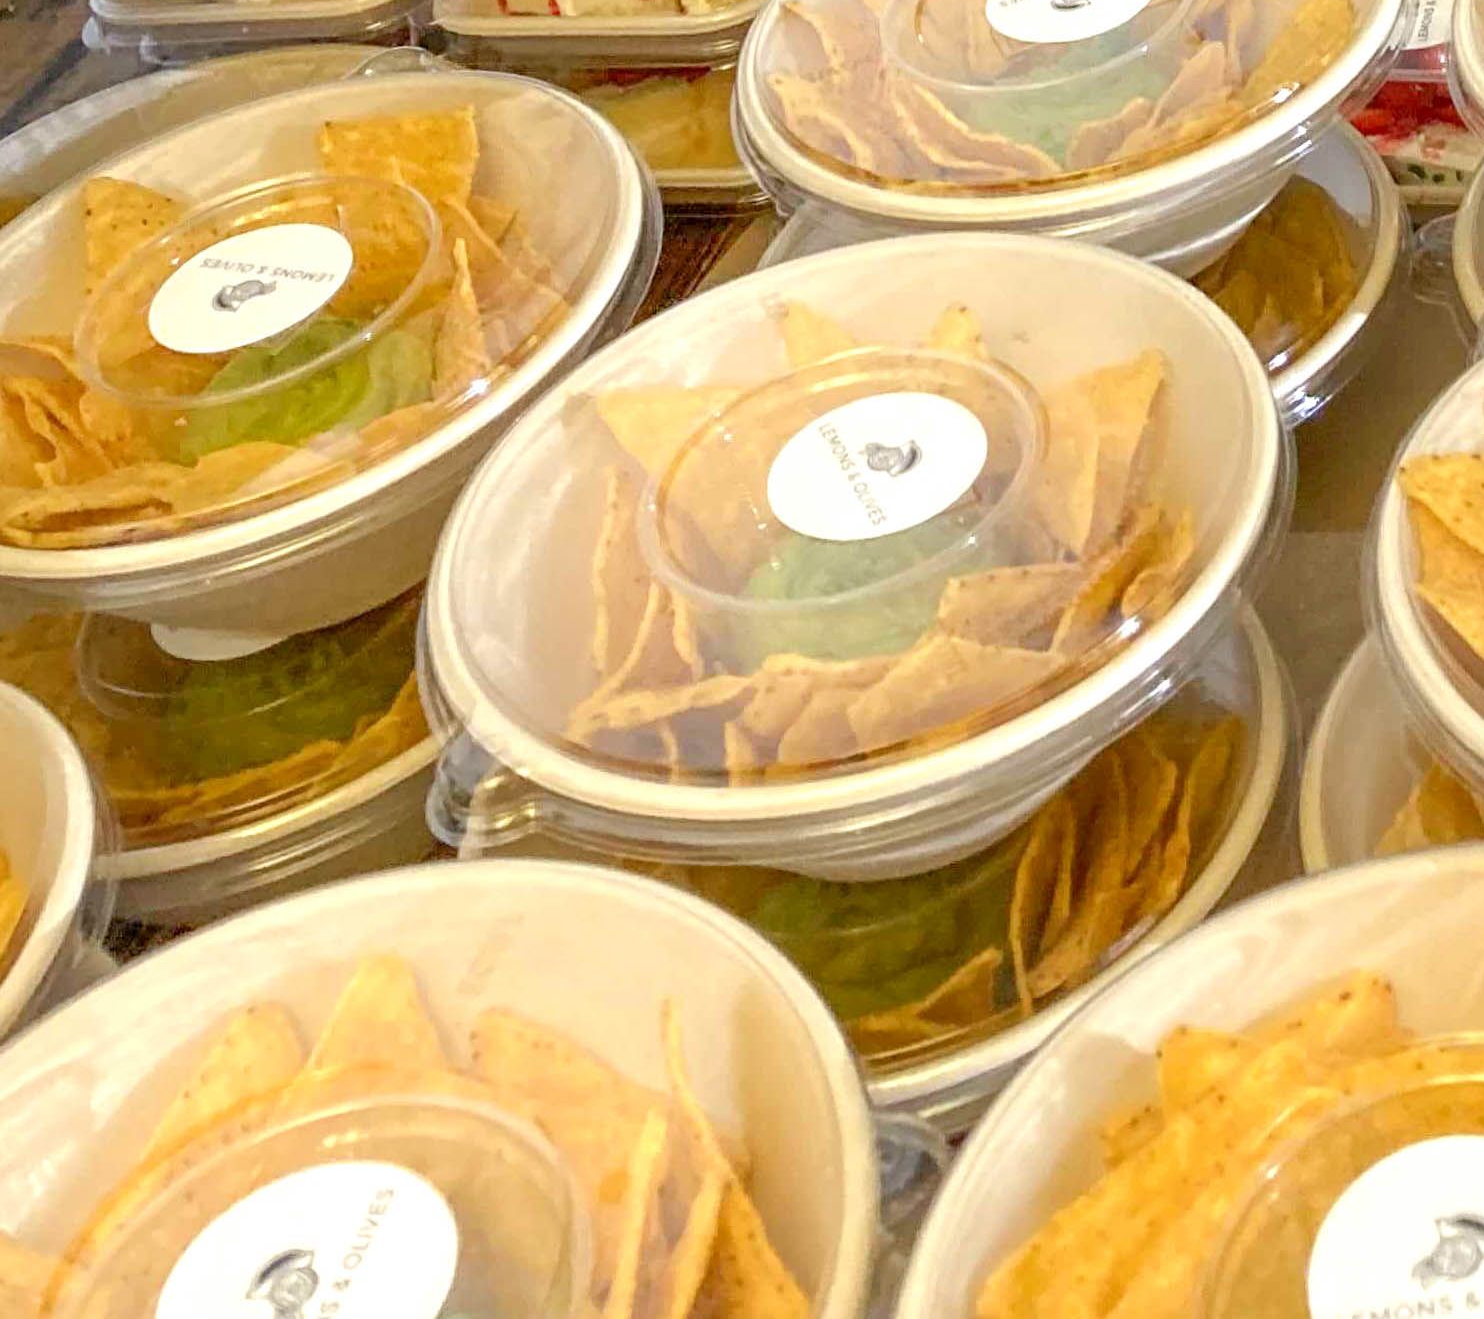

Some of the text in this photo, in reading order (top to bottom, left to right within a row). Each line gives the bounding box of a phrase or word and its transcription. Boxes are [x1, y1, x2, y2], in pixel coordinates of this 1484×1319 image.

[1417, 7, 1435, 42] LEMONS
[199, 257, 256, 275] OLIVES
[269, 266, 336, 283] LEMONS
[818, 421, 857, 473] LEMONS
[852, 481, 888, 526] OLIVES
[342, 1187, 395, 1270] OLIVES
[1349, 1296, 1454, 1319] MONS
[1465, 1291, 1480, 1309] &
